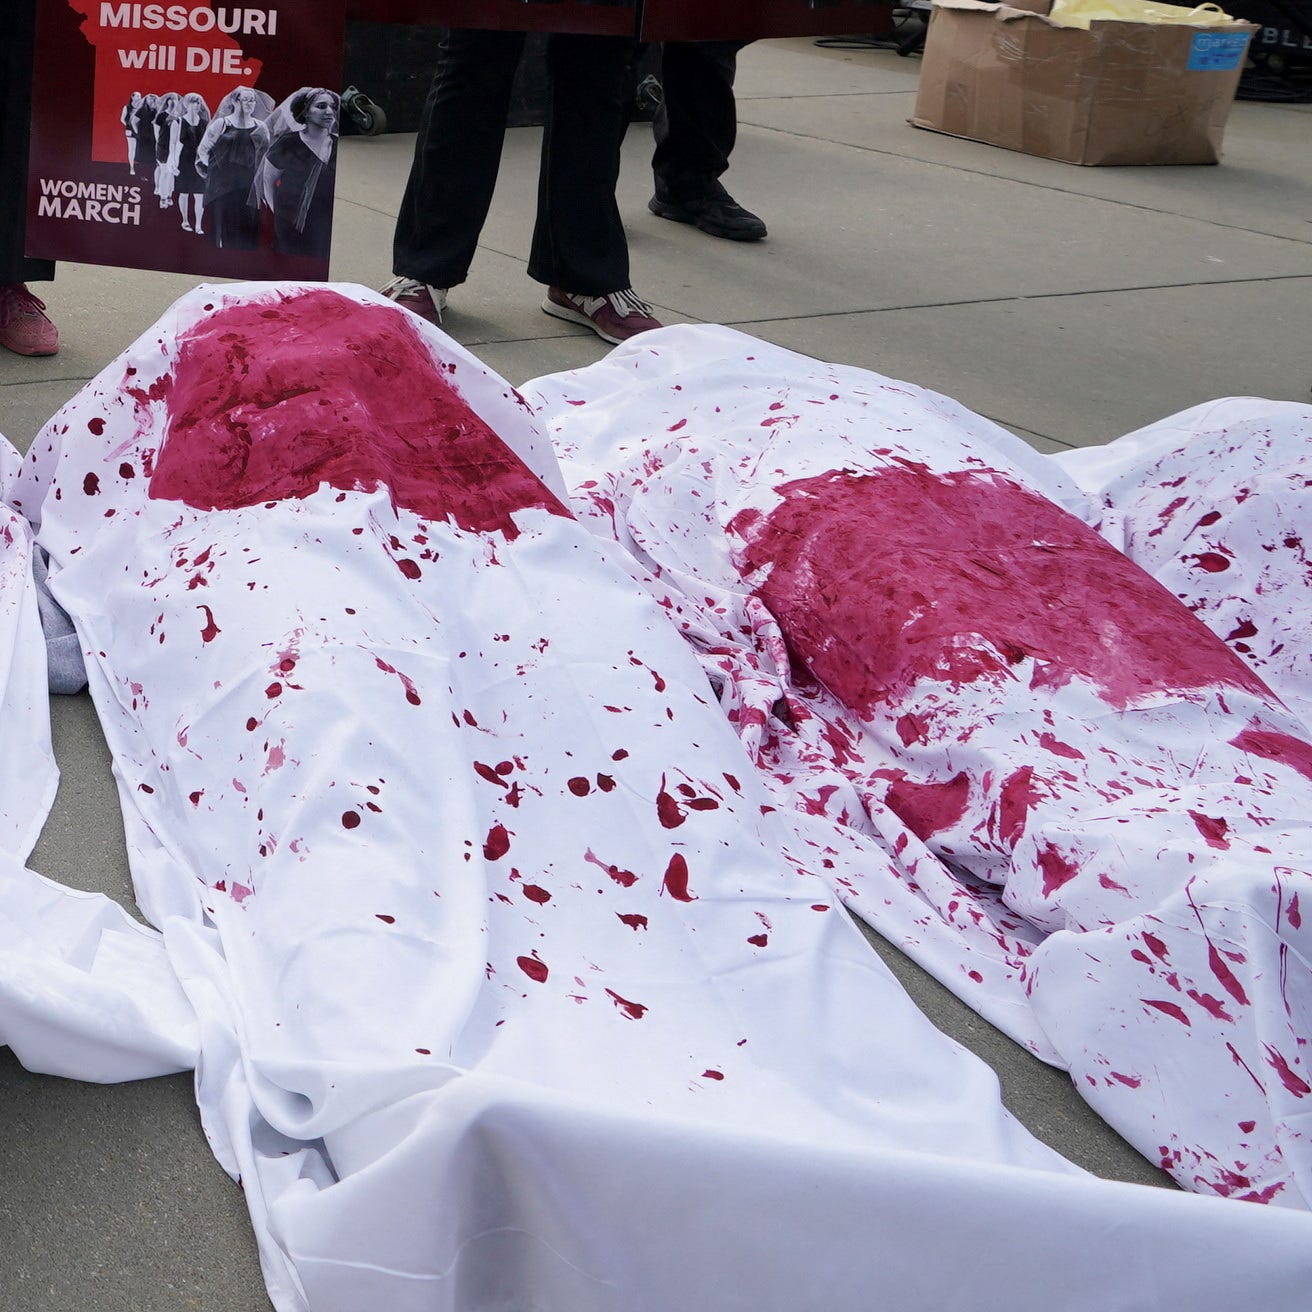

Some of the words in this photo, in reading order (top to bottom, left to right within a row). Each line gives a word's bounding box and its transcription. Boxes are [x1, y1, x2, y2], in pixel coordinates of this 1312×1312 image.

[100, 2, 277, 35] MISSOURI
[118, 44, 176, 70] will
[186, 47, 252, 75] DIE.
[39, 178, 141, 203] WOMEN'S
[37, 196, 141, 226] MARCH
